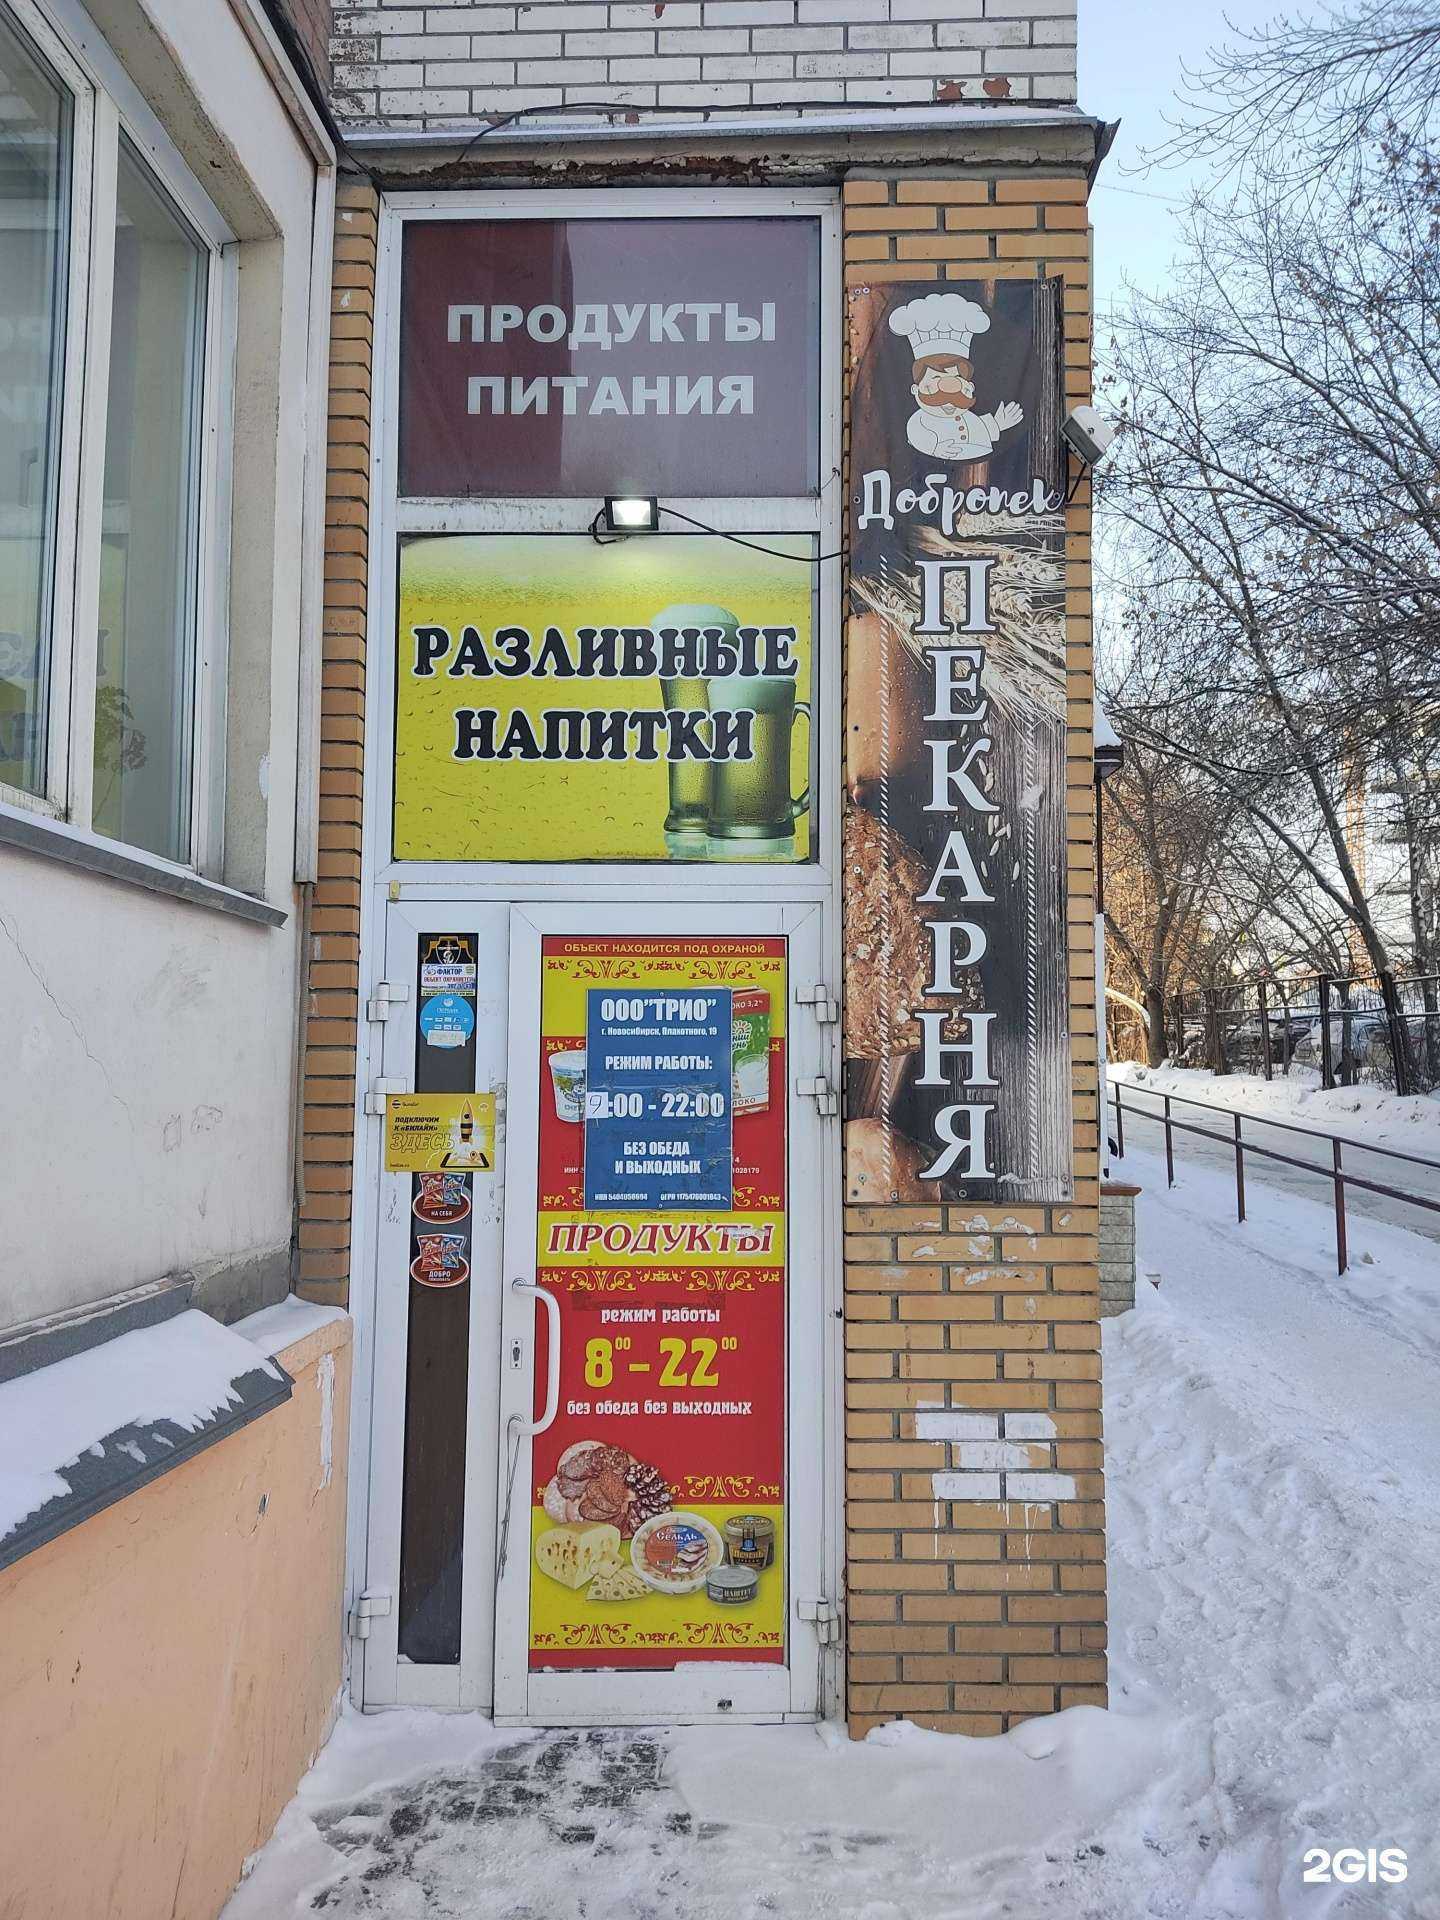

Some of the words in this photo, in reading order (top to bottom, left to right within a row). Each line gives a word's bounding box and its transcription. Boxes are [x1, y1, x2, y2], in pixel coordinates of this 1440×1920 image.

[447, 302, 776, 350] ПРОДУКТЫ
[467, 376, 754, 415] ПИТАНИЯ
[413, 626, 799, 678] РАЗЛИВНЫЕ
[453, 709, 755, 761] НАПИТКИ
[914, 560, 1000, 1180] ПЕКАРНЯ
[564, 943, 609, 953] ОБЪЕКТ
[612, 943, 680, 954] НАХОДИТСЯ
[684, 943, 709, 954] ПОД
[711, 942, 765, 954] ОХРАНОЙ
[607, 1026, 661, 1037] Новосибирск,
[708, 1026, 718, 1036] 19
[605, 1055, 652, 1070] РЕЖИМ
[654, 1055, 713, 1070] РАБОТЫ:
[589, 1092, 643, 1118] 9:00
[661, 1093, 725, 1118] 22:00
[390, 1132, 455, 1153] ЗДЕСЬ
[623, 1141, 647, 1156] БЕЗ
[648, 1141, 691, 1158] ОБЕДА
[614, 1160, 624, 1175] И
[625, 1160, 702, 1176] ВЫХОДНЫХ
[546, 1223, 775, 1254] ПРОДУКТЫ
[601, 1308, 656, 1323] режим
[662, 1306, 721, 1323] работы
[567, 1400, 591, 1415] без
[596, 1400, 639, 1416] обеда
[644, 1400, 668, 1415] без
[673, 1401, 752, 1417] выходных
